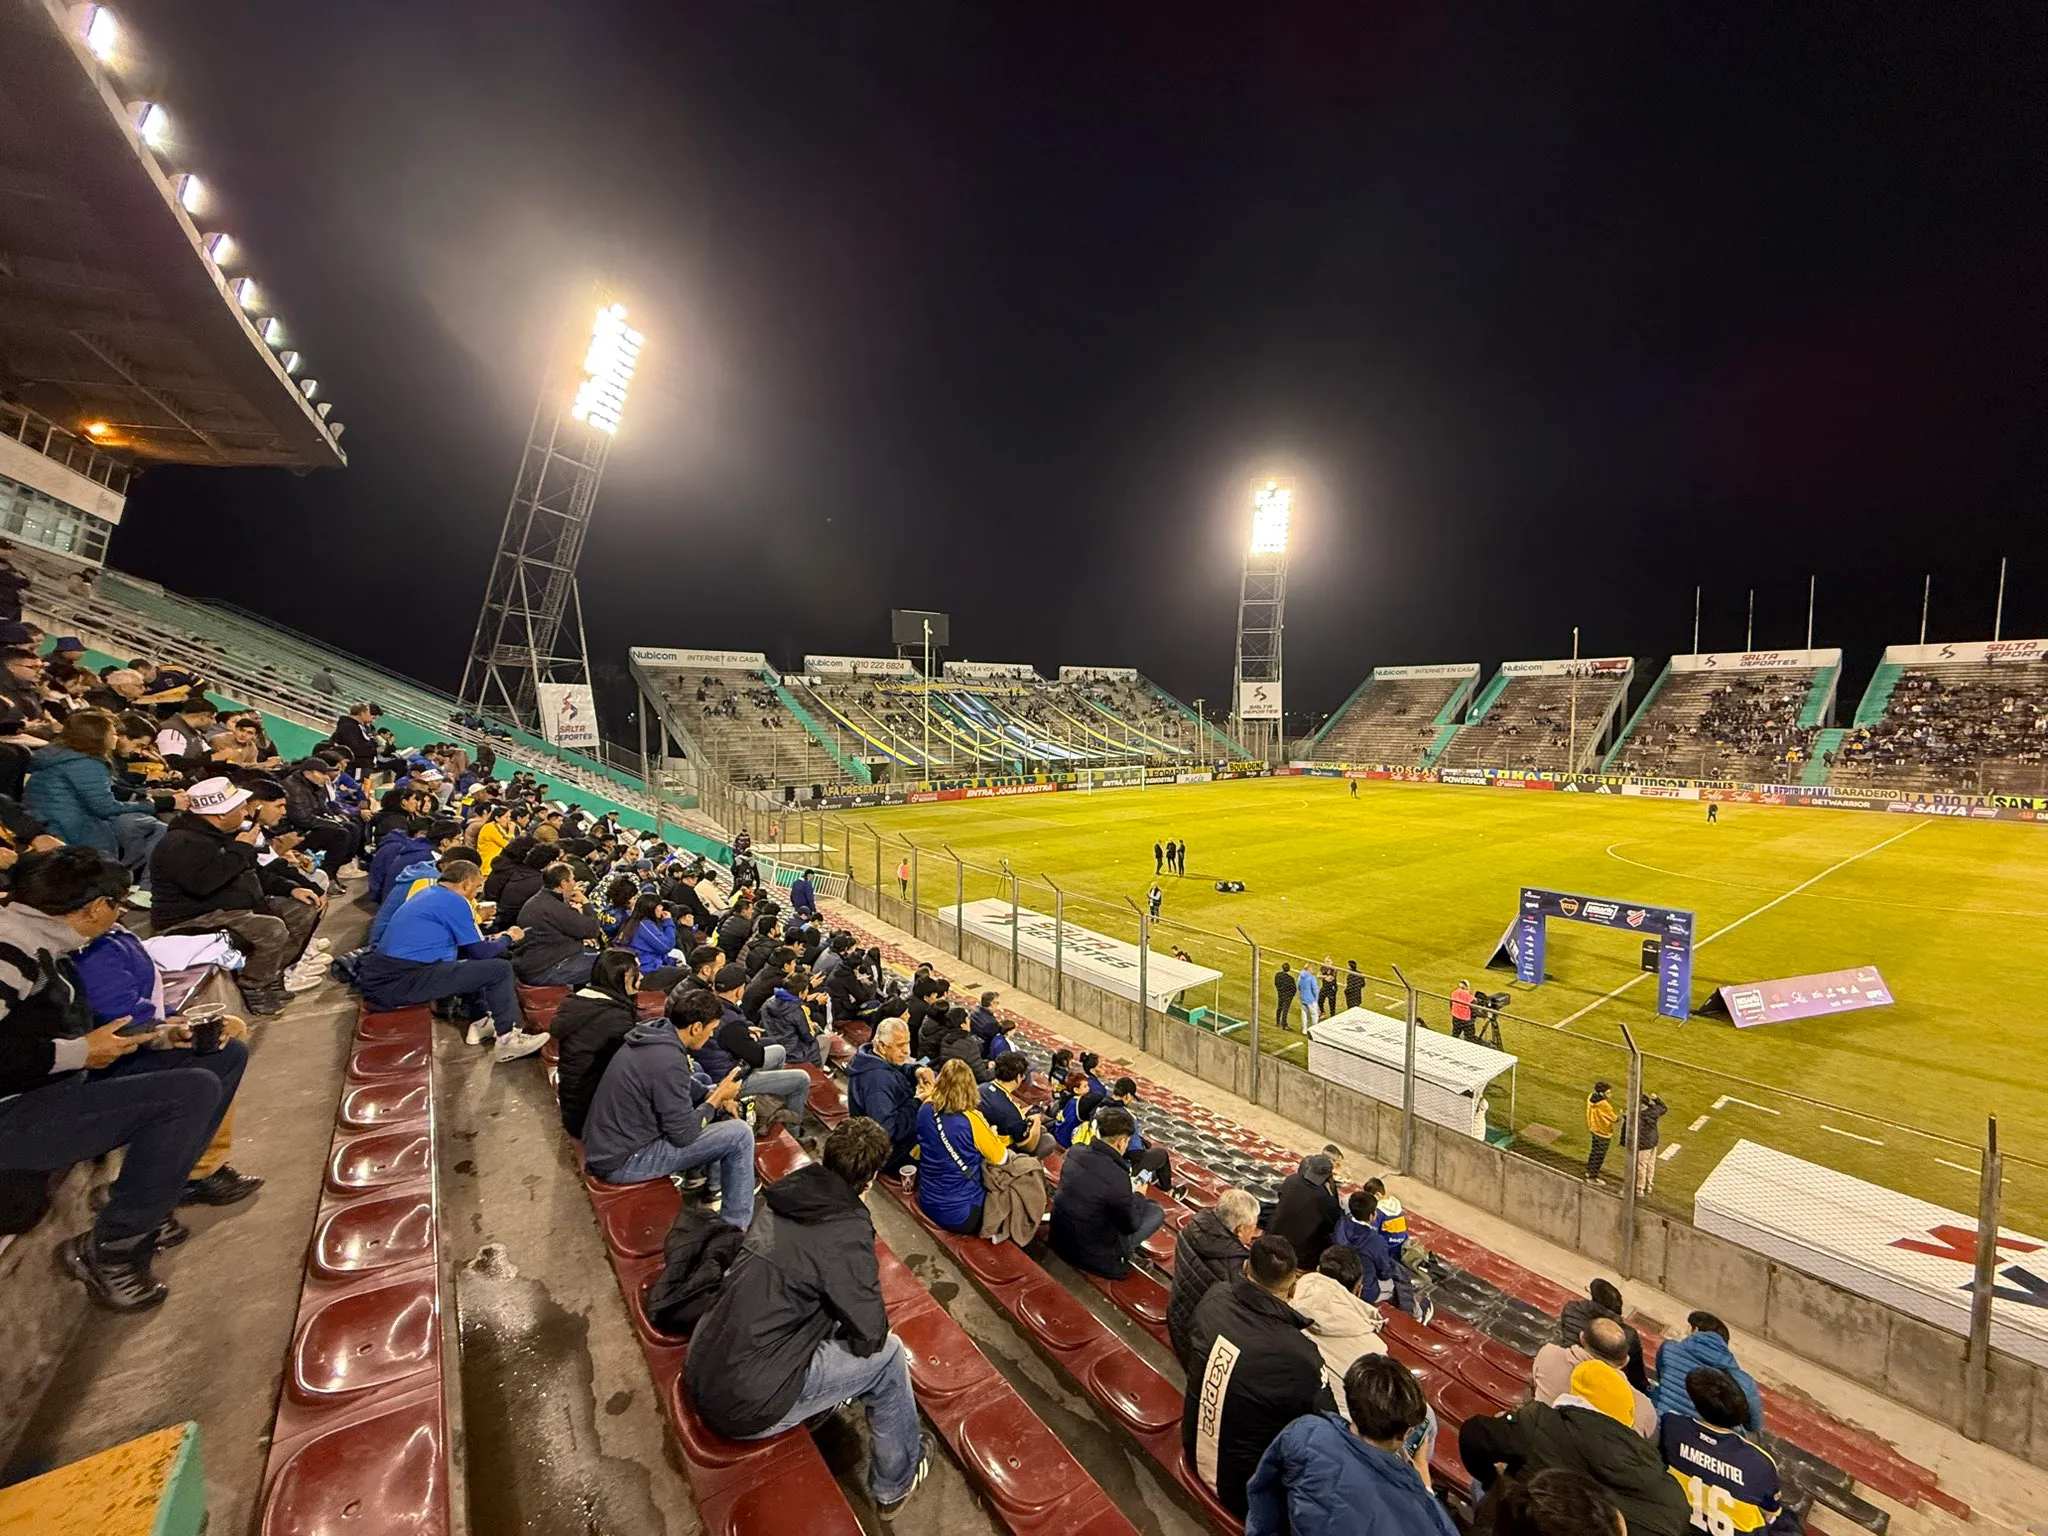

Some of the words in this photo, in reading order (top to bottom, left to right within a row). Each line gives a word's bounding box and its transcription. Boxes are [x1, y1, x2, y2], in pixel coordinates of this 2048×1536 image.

[1984, 642, 2038, 652] SALTA
[687, 654, 725, 662] INTERNET
[1740, 653, 1779, 661] SALTA
[1984, 650, 2044, 660] DEPORT
[870, 661, 885, 669] 222
[886, 662, 905, 670] 6824
[1740, 659, 1798, 667] DEPORTES
[1503, 664, 1542, 673] Nubicom
[560, 725, 586, 733] SALTA
[555, 733, 592, 741] DEPORTES
[1230, 761, 1265, 771] BOULOGNE
[1442, 775, 1487, 785] POWERADE
[1693, 780, 1734, 789] TAPIALES
[841, 784, 886, 796] PRESENTE
[1640, 786, 1680, 797] ESPN
[1834, 787, 1898, 798] BARADERO
[192, 792, 226, 808] BOCA
[1811, 798, 1871, 809] BETWARRIOR
[1995, 797, 2034, 809] SAN
[1913, 803, 1968, 816] SALTA
[1202, 1346, 1234, 1437] Kappa
[1680, 1442, 1745, 1486] M.MERENTIEL
[1688, 1475, 1735, 1536] 16
